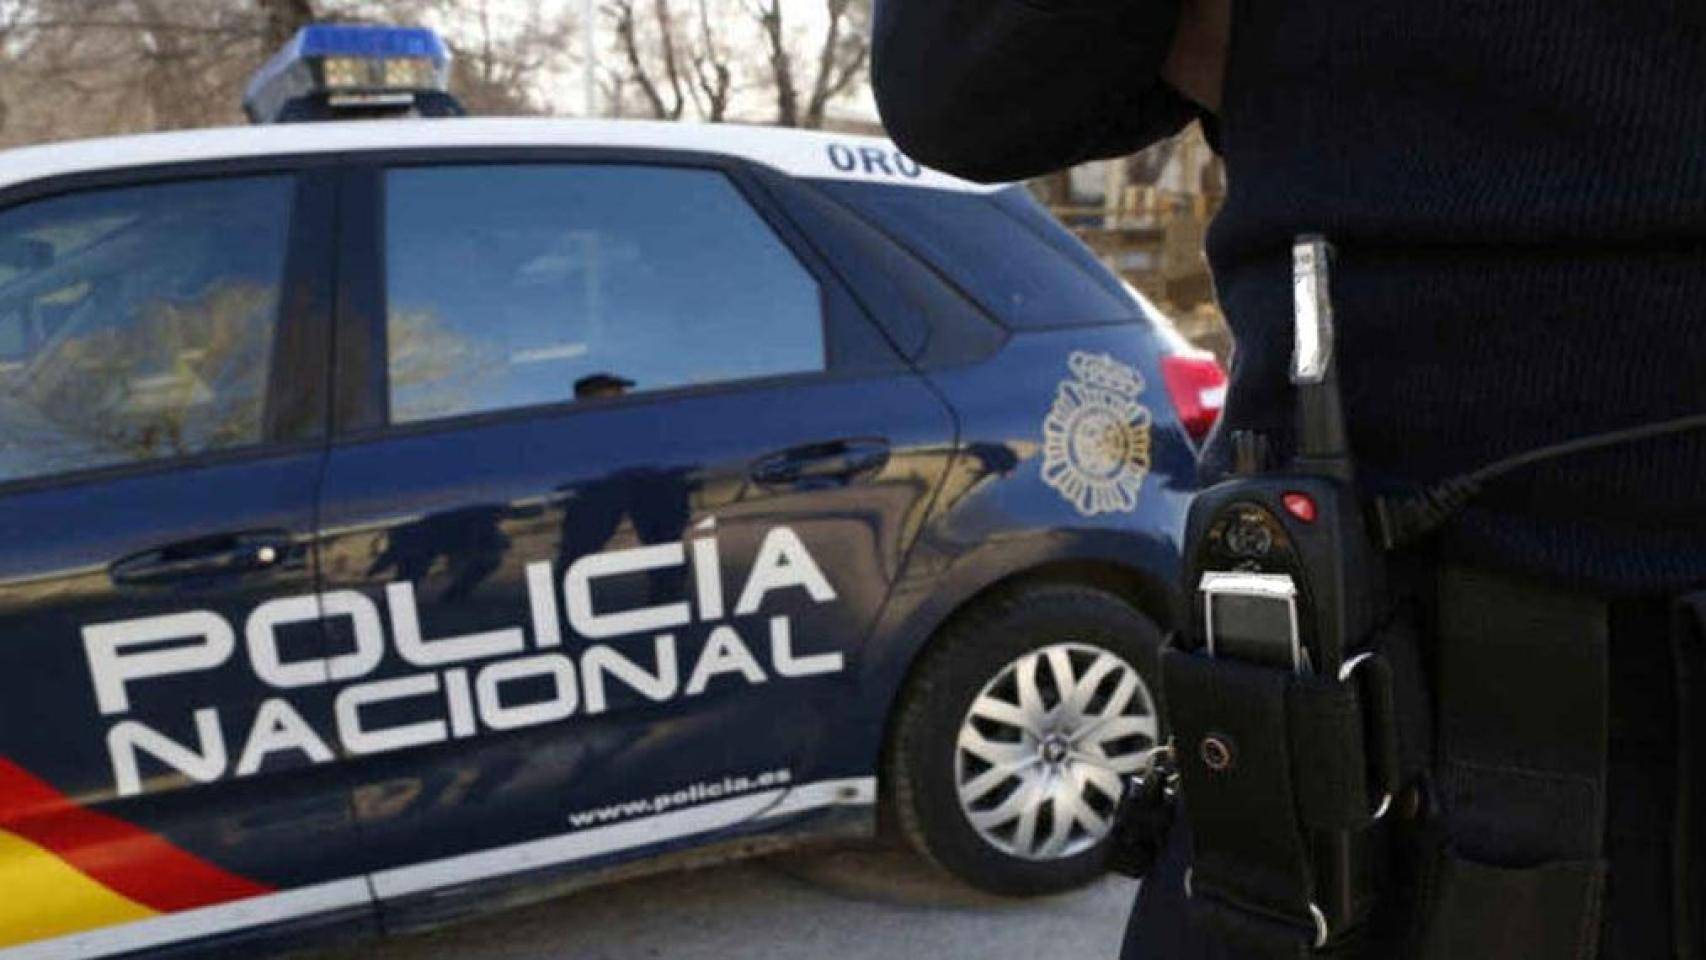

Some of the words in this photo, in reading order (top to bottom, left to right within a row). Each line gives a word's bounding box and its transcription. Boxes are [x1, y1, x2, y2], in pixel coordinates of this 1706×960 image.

[82, 517, 837, 713] POLICÍA
[106, 616, 844, 796] NACIONAL
[569, 768, 791, 826] www.policia.es
